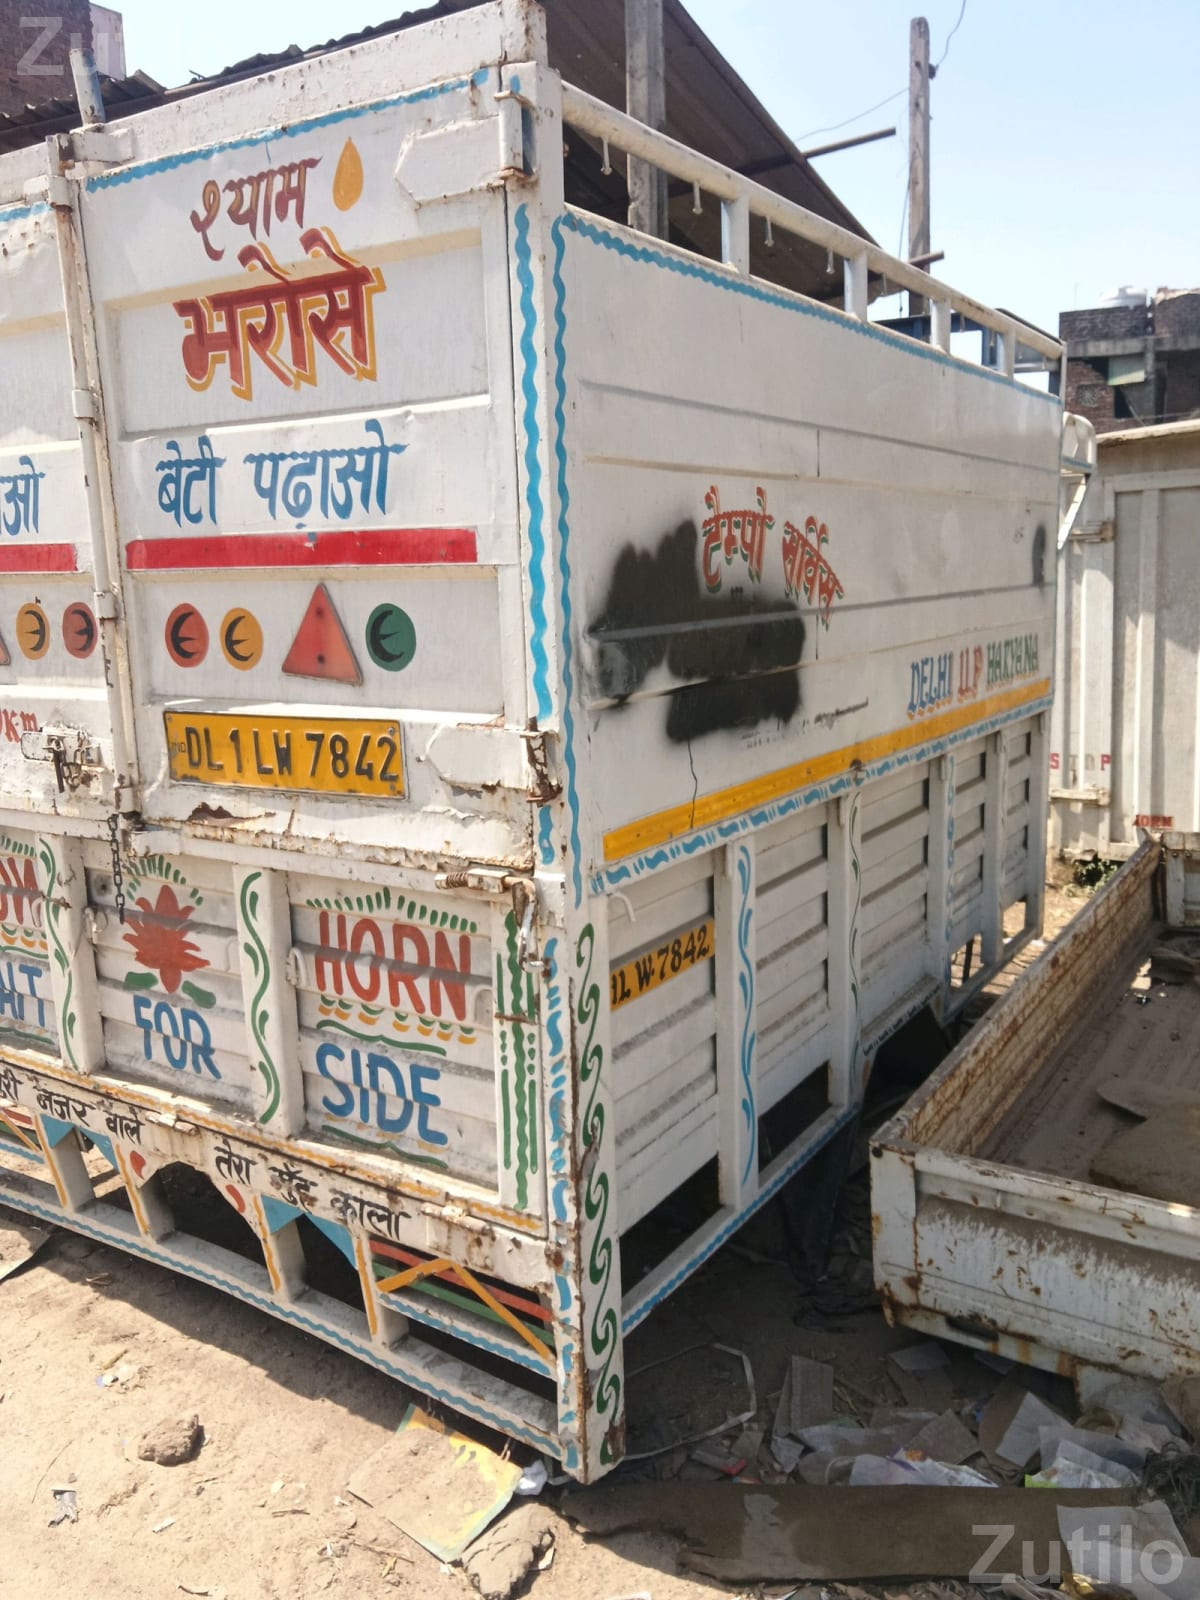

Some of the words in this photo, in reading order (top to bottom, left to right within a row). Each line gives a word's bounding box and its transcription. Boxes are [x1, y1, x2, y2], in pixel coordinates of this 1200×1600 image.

[190, 156, 323, 261] श्याम
[172, 226, 386, 400] भरोसे
[155, 434, 226, 528] बेटी
[305, 732, 400, 782] 7842
[315, 910, 471, 1022] HORN
[133, 994, 222, 1080] FOR
[315, 1042, 448, 1146] SIDE
[214, 1138, 257, 1185] तेरा
[329, 1188, 411, 1240] काला
